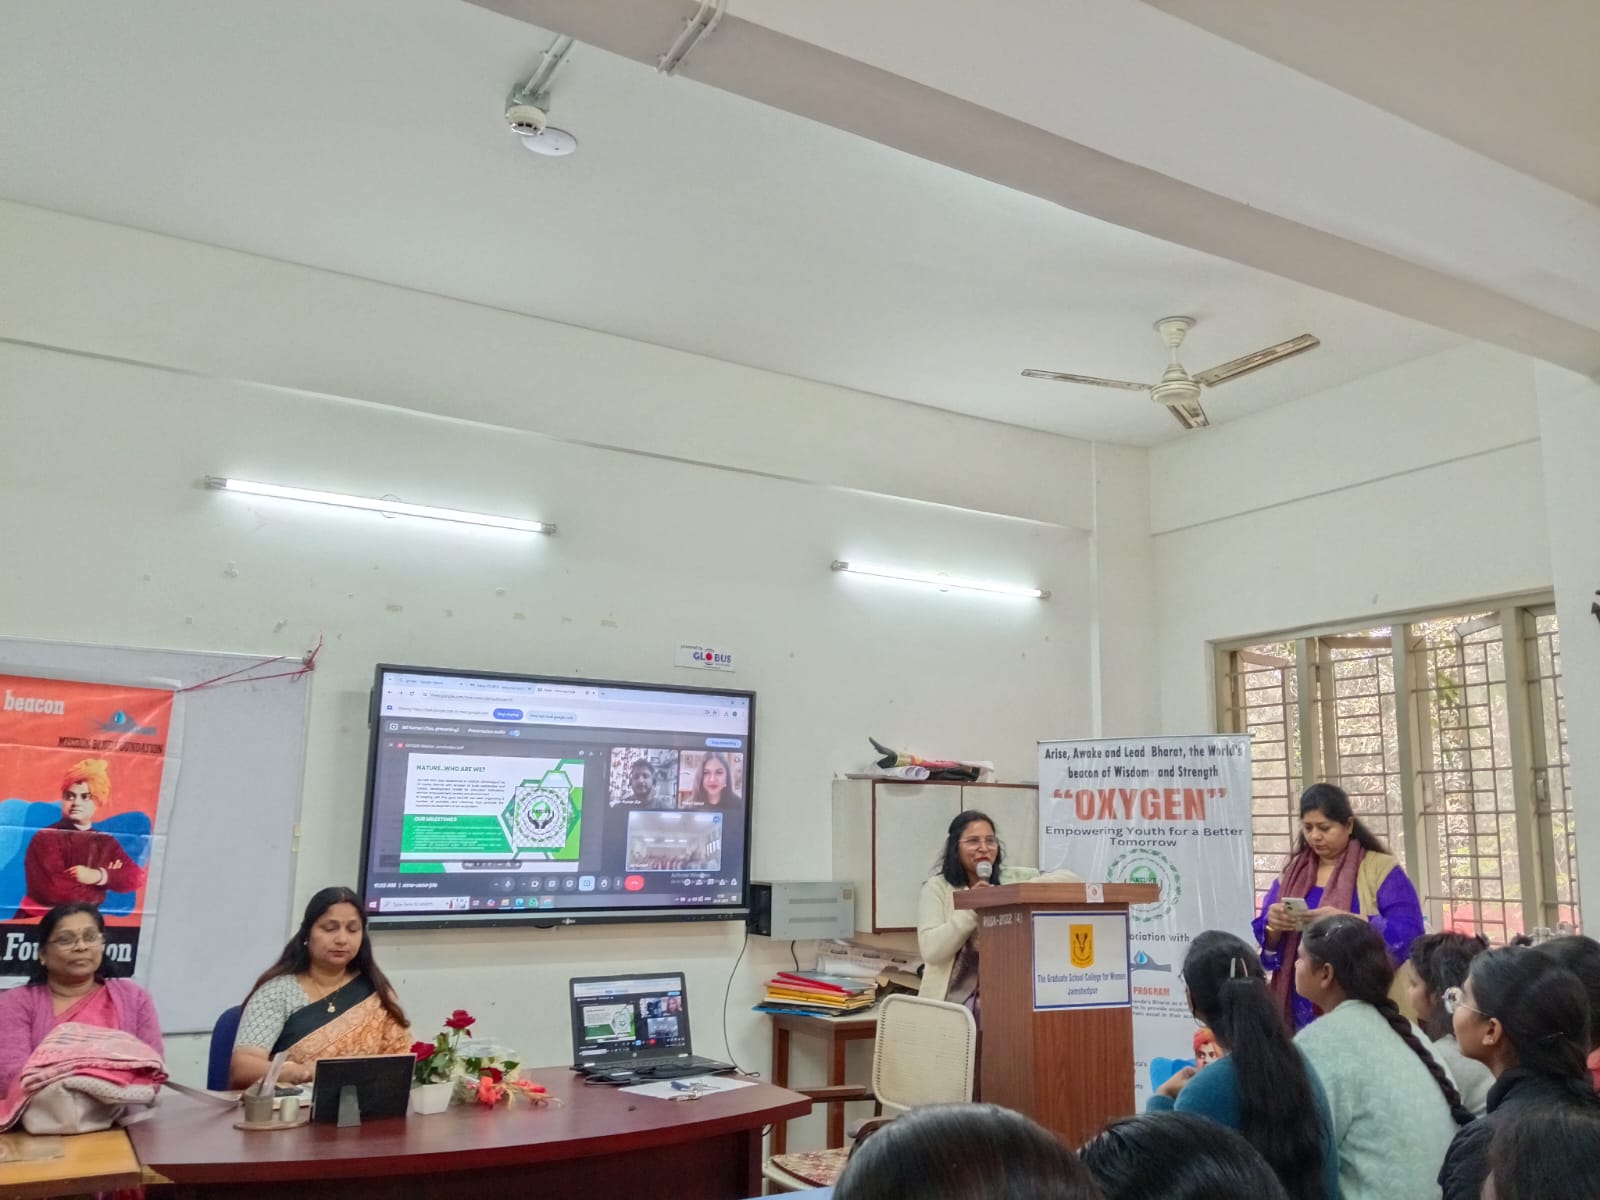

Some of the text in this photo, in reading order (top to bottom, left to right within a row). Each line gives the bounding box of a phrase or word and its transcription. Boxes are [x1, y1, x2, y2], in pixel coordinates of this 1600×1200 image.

[3, 689, 65, 715] beacon
[115, 741, 163, 754] OUNDATION
[1044, 744, 1243, 760] Arise, Awake and Lead Bharat, the World's
[1068, 765, 1219, 780] beacon of Wisdom and Strength
[1045, 826, 1123, 838] Empowering
[1126, 826, 1166, 836] Youth
[1169, 826, 1187, 836] for
[1203, 827, 1244, 836] Better
[1110, 837, 1177, 847] Tomorrow
[1169, 933, 1190, 942] with
[3, 932, 132, 962] Fouon
[1037, 974, 1046, 983] The
[1047, 973, 1068, 983] Graduate
[1069, 973, 1084, 982] School
[1085, 972, 1102, 982] College
[1110, 972, 1126, 980] Women
[1133, 986, 1170, 996] PROGRAM
